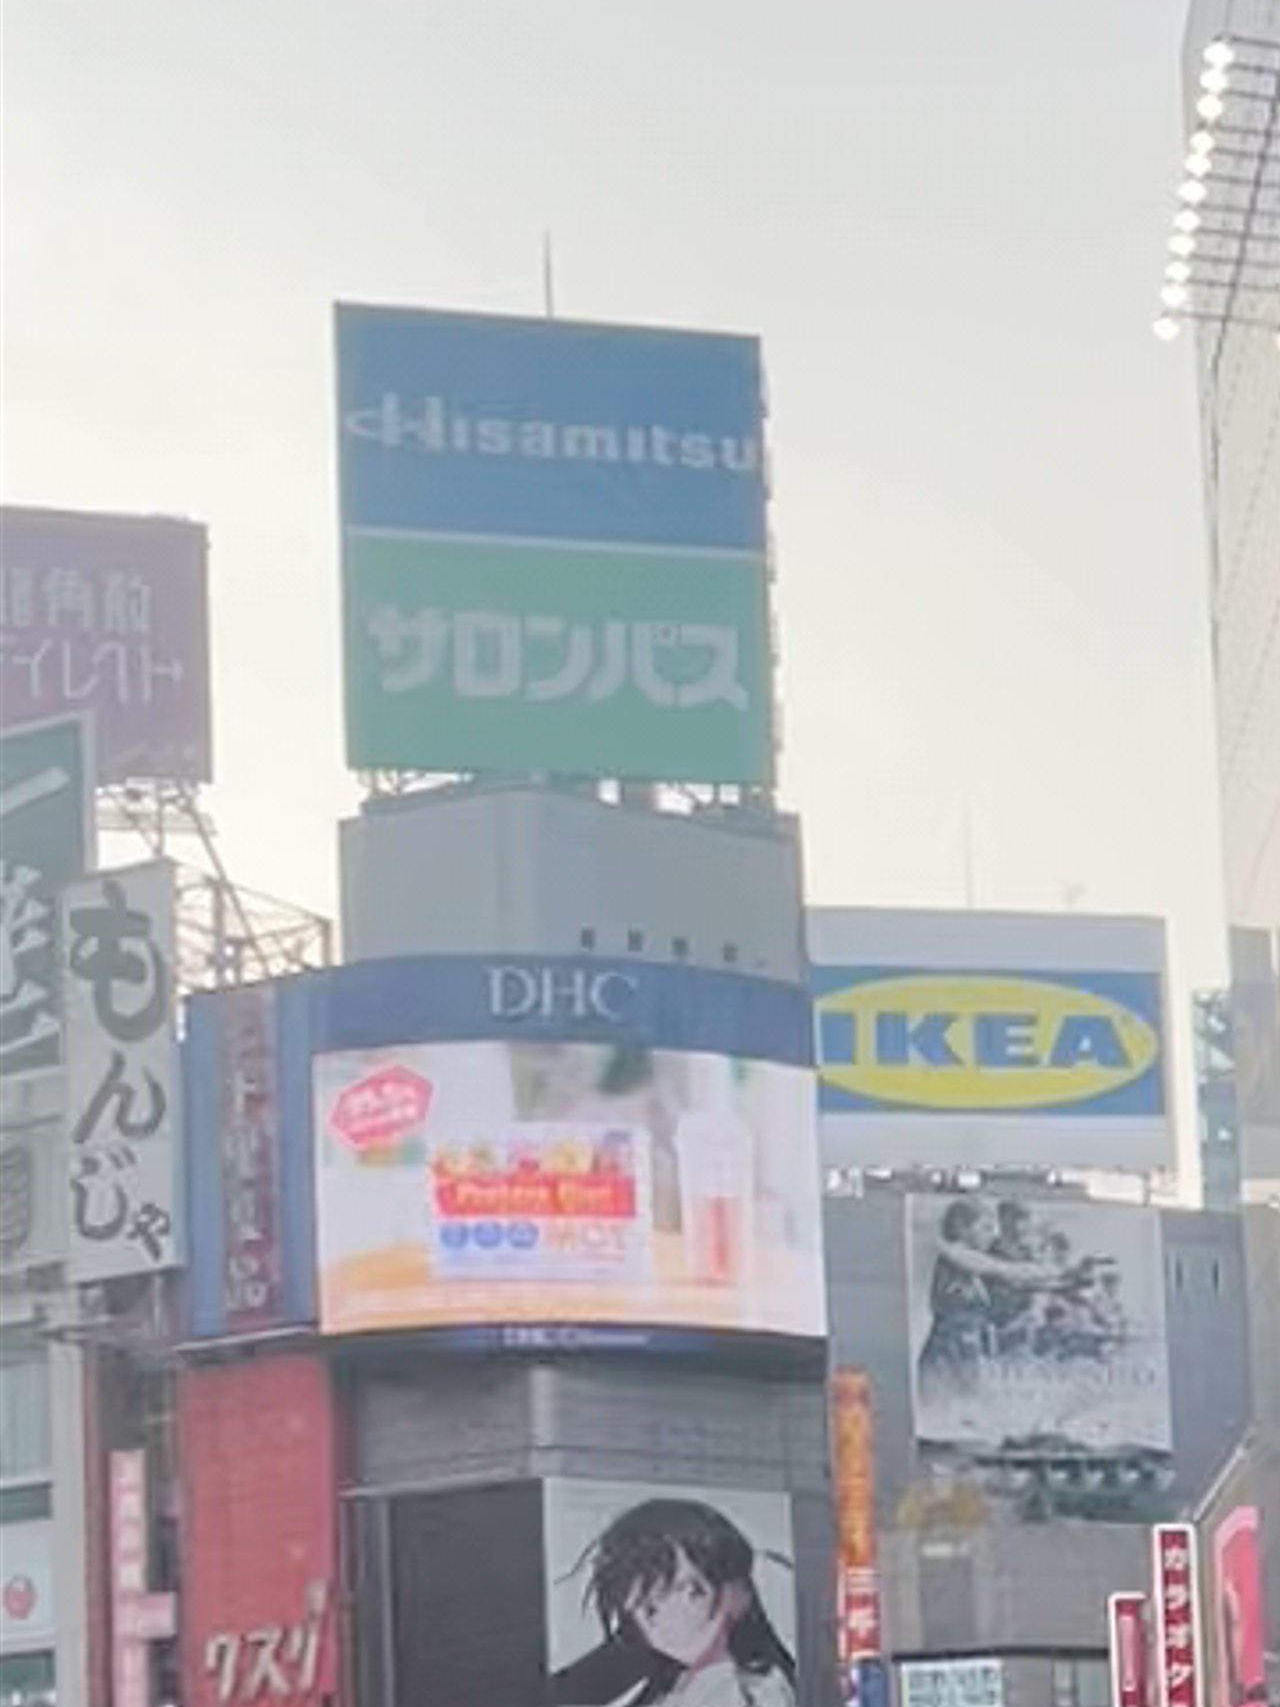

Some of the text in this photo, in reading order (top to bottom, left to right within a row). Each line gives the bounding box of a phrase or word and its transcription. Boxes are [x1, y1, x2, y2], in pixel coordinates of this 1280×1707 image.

[348, 392, 758, 471] Hisamitsu
[366, 602, 751, 712] サロンパス
[487, 966, 639, 1021] DHC
[818, 1010, 1135, 1069] IKEA
